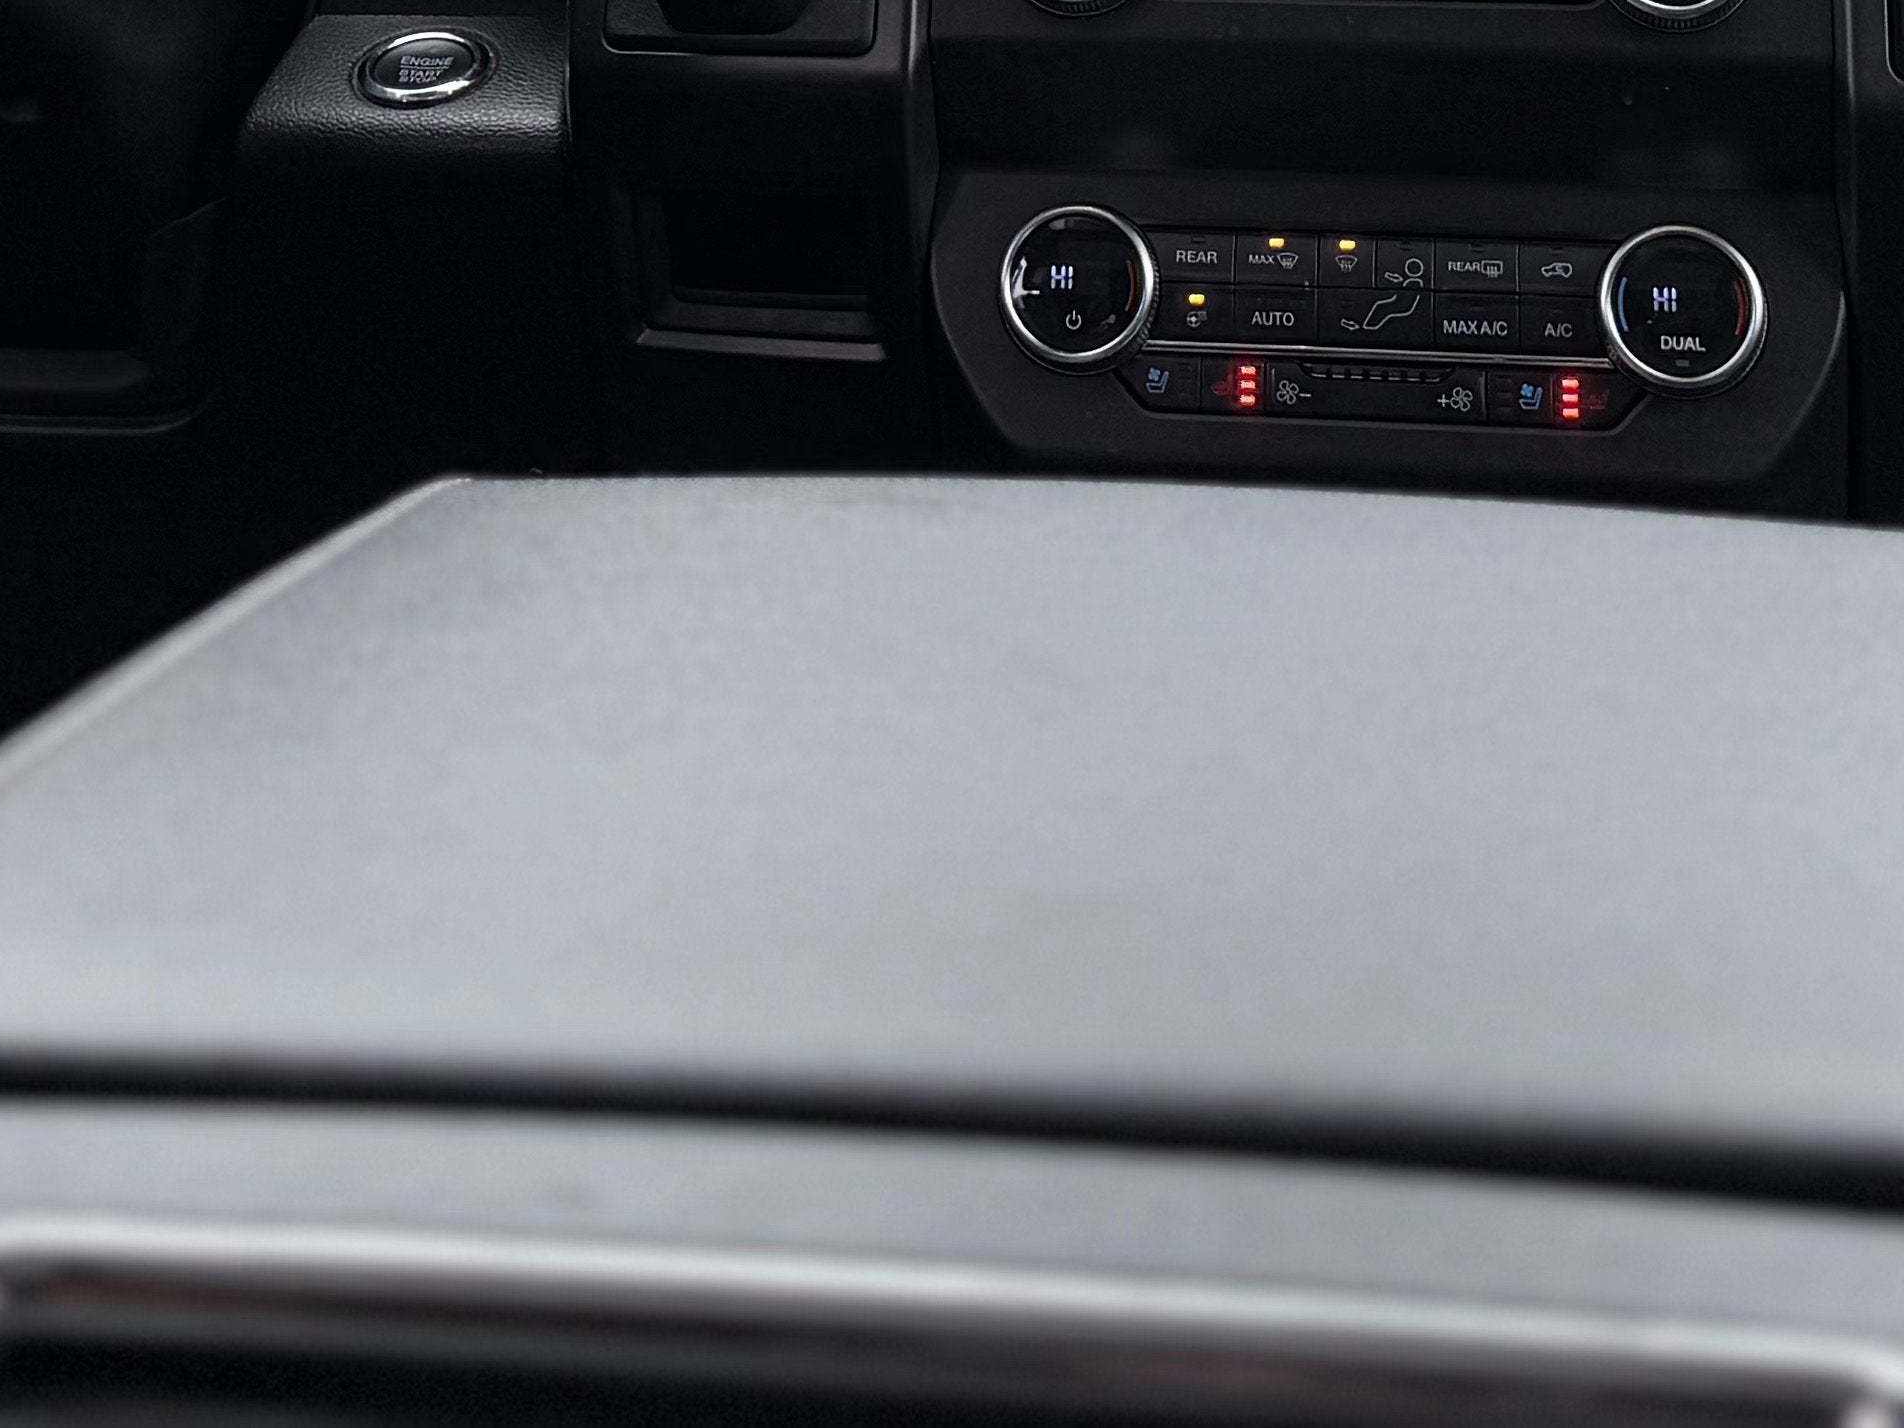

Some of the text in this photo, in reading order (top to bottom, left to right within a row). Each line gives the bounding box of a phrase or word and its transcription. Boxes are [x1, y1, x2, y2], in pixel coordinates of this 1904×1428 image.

[399, 55, 455, 67] ENGINE
[399, 68, 443, 77] START
[1175, 249, 1218, 264] REAR
[1248, 254, 1275, 265] MAX
[1447, 260, 1481, 272] REAR
[1050, 265, 1075, 290] HI
[1652, 286, 1678, 312] HI
[1251, 311, 1295, 327] AUTO
[1443, 320, 1508, 336] MAX A/C
[1544, 322, 1573, 338] A/C
[1660, 335, 1706, 352] DUAL
